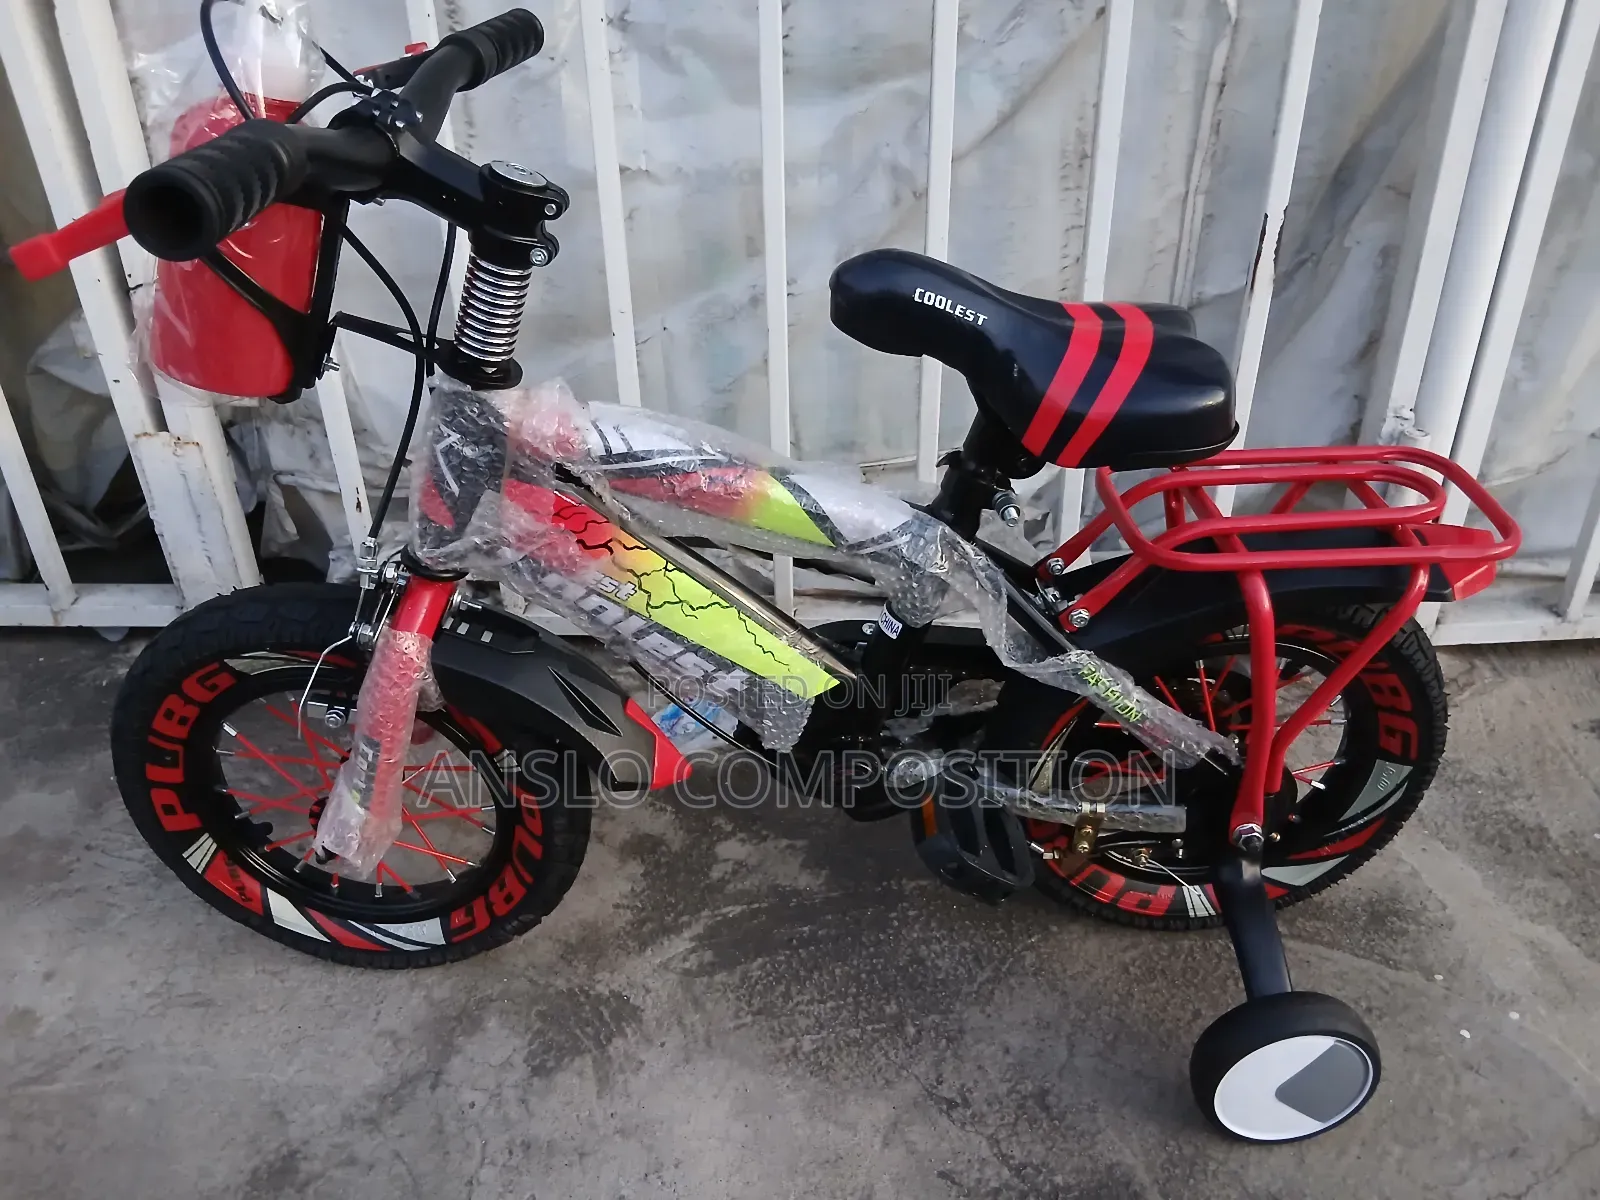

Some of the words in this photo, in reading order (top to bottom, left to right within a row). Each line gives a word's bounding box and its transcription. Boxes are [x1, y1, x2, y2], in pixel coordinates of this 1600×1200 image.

[913, 287, 988, 326] COOLEST
[880, 612, 900, 636] CHINA
[145, 662, 238, 832] PUBG
[449, 779, 544, 943] PUBG
